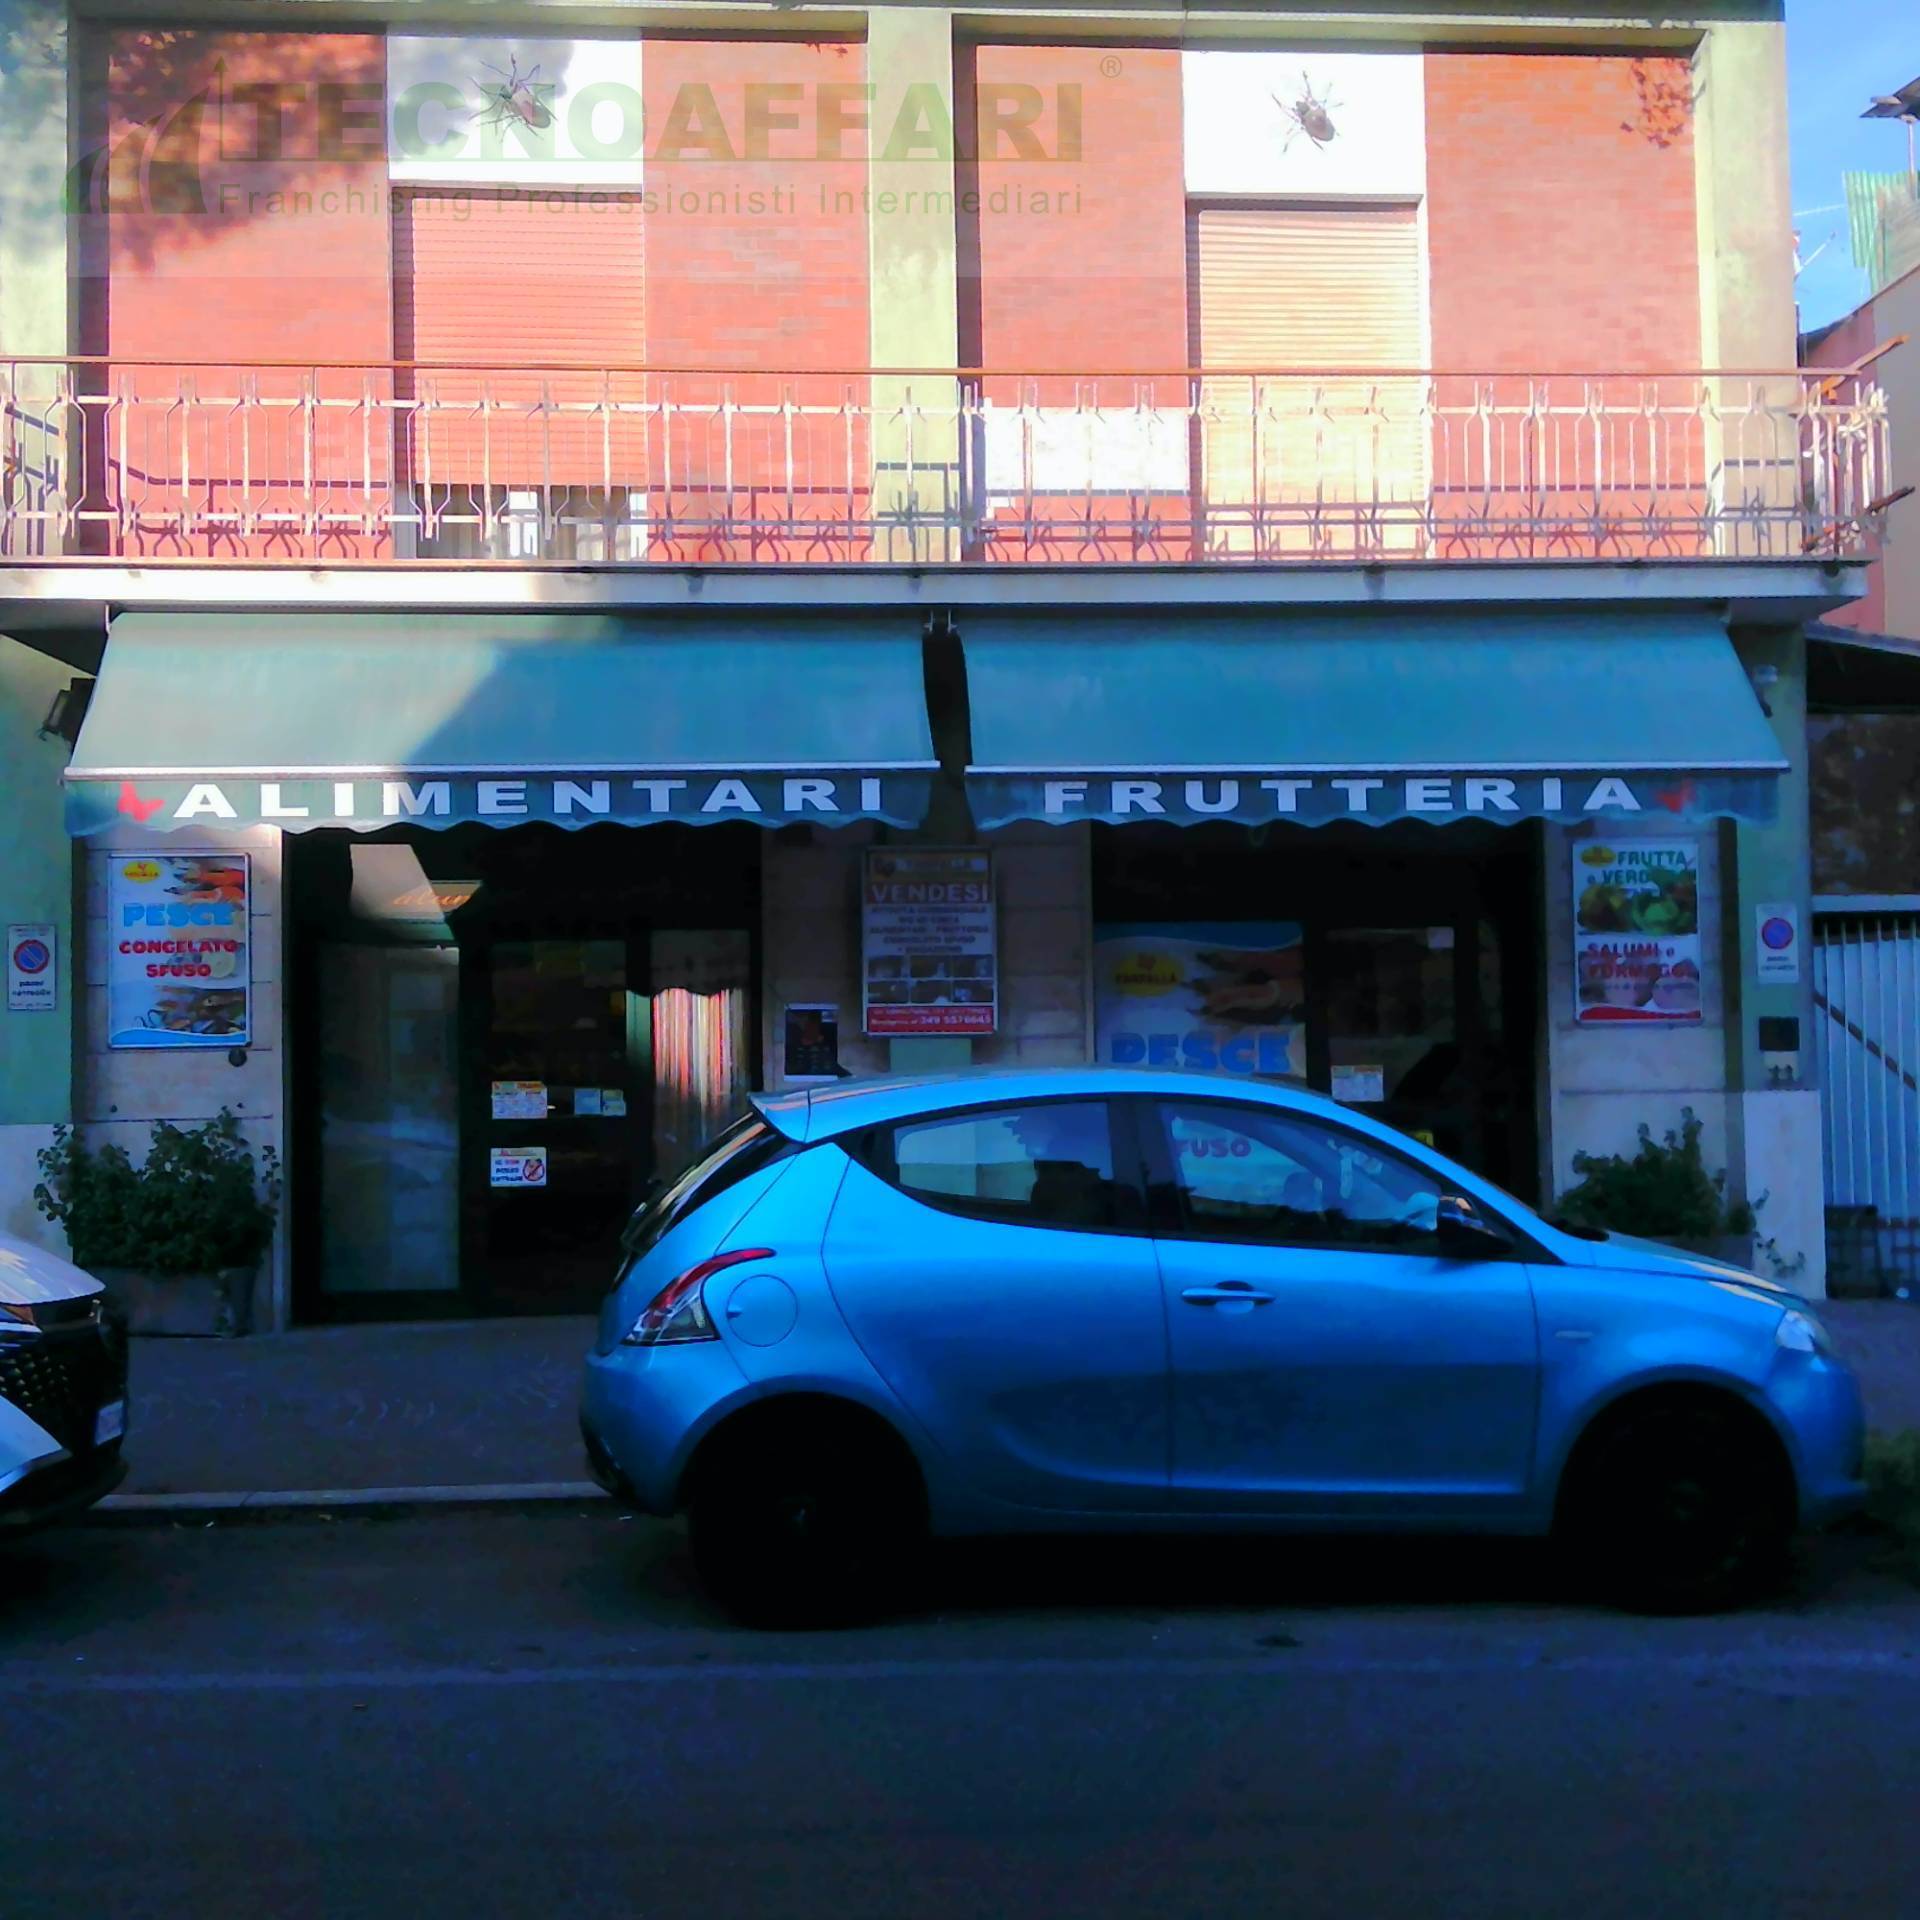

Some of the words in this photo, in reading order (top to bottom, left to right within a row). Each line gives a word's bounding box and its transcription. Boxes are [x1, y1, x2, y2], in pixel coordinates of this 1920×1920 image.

[173, 778, 881, 818] ALIMENTARI
[1044, 777, 1641, 814] FRUTTERIA
[1617, 850, 1688, 867] FRUTTA
[871, 882, 988, 902] VENDESI
[122, 902, 237, 928] PESCE
[118, 938, 240, 955] CONGELATO
[145, 963, 212, 978] SFUSO
